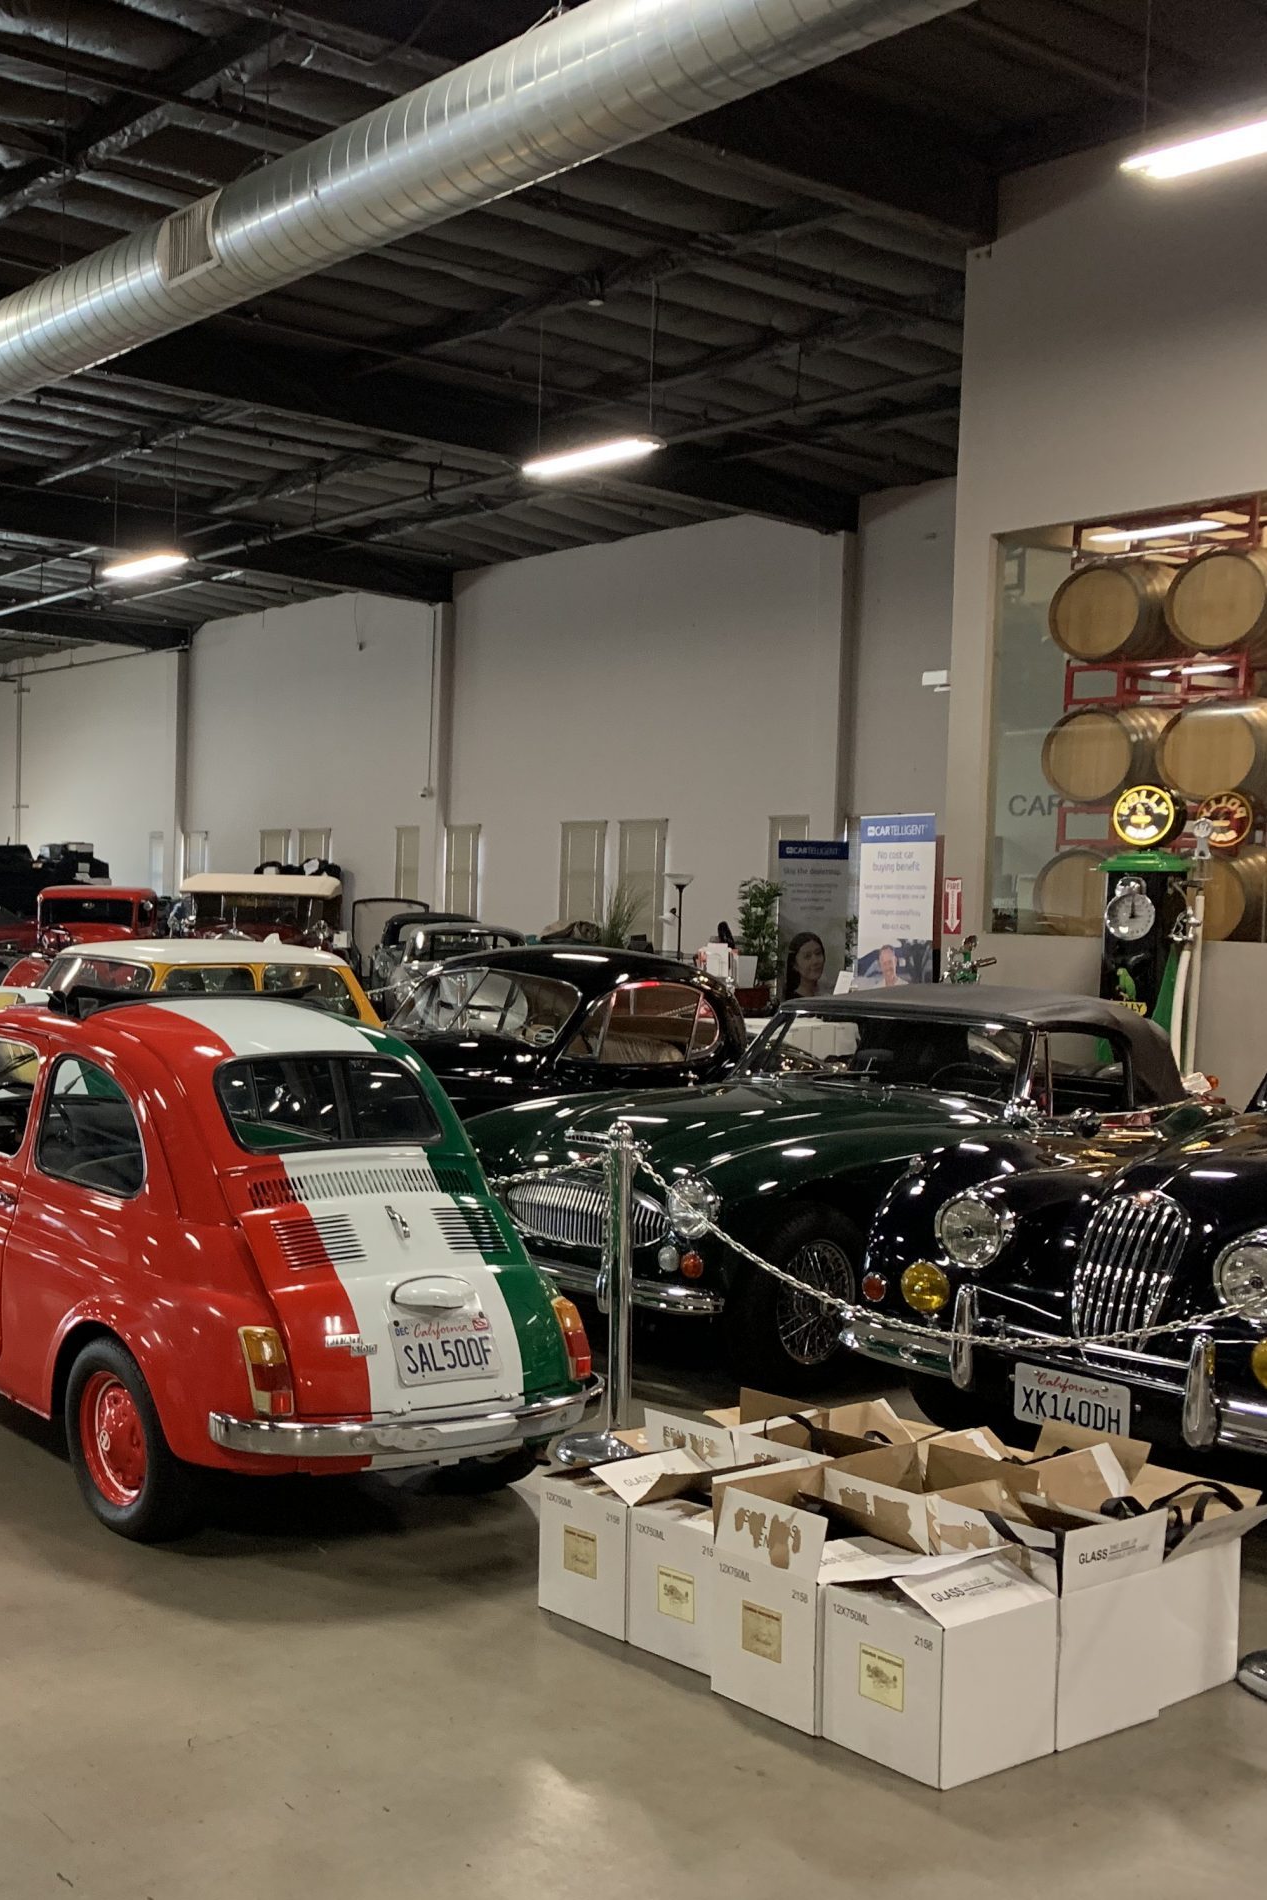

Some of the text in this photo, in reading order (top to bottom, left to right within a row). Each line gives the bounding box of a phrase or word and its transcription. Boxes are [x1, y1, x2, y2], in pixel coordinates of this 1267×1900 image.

[1118, 789, 1169, 816] POLLY
[877, 851, 914, 859] No cost car
[872, 861, 920, 873] buying benefit
[946, 882, 960, 890] FIRE
[395, 1327, 409, 1337] DEC
[413, 1322, 473, 1340] California
[403, 1335, 492, 1375] SAL500F
[1037, 1372, 1107, 1399] California
[635, 1522, 666, 1542] 12X750ML
[701, 1545, 714, 1558] 215
[1078, 1548, 1109, 1565] GLASS
[718, 1562, 752, 1583] 12X750ML
[931, 1586, 966, 1603] GLASS
[832, 1602, 870, 1626] 12X750ML
